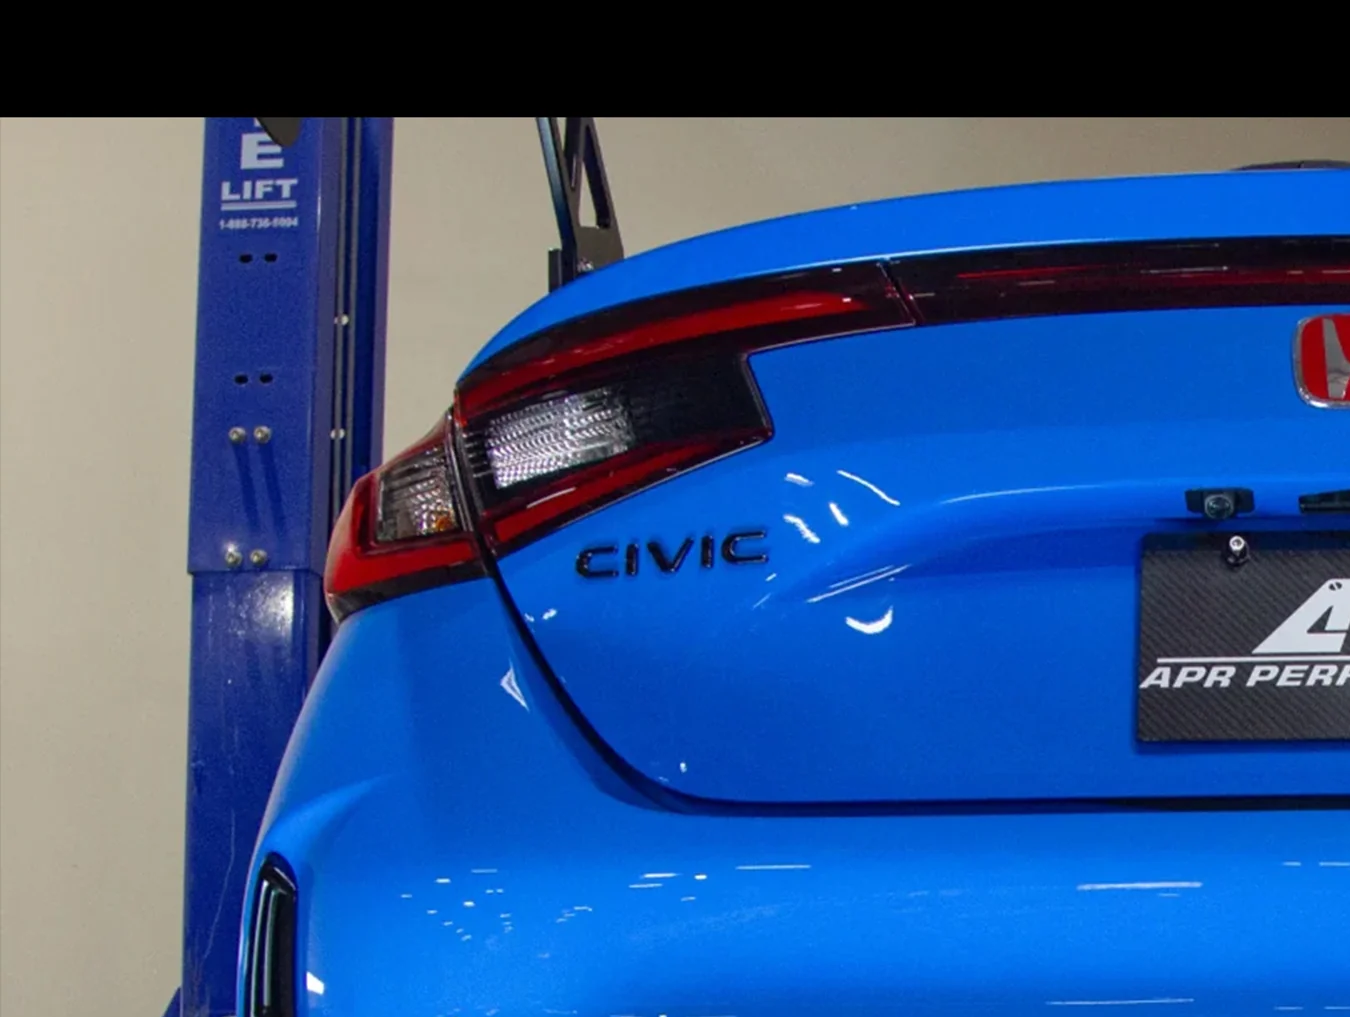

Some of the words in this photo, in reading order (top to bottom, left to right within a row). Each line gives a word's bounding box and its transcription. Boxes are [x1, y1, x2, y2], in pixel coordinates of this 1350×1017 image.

[240, 132, 284, 170] E
[220, 178, 298, 201] LIFT
[575, 530, 768, 578] CIVIC
[1139, 664, 1237, 689] APR
